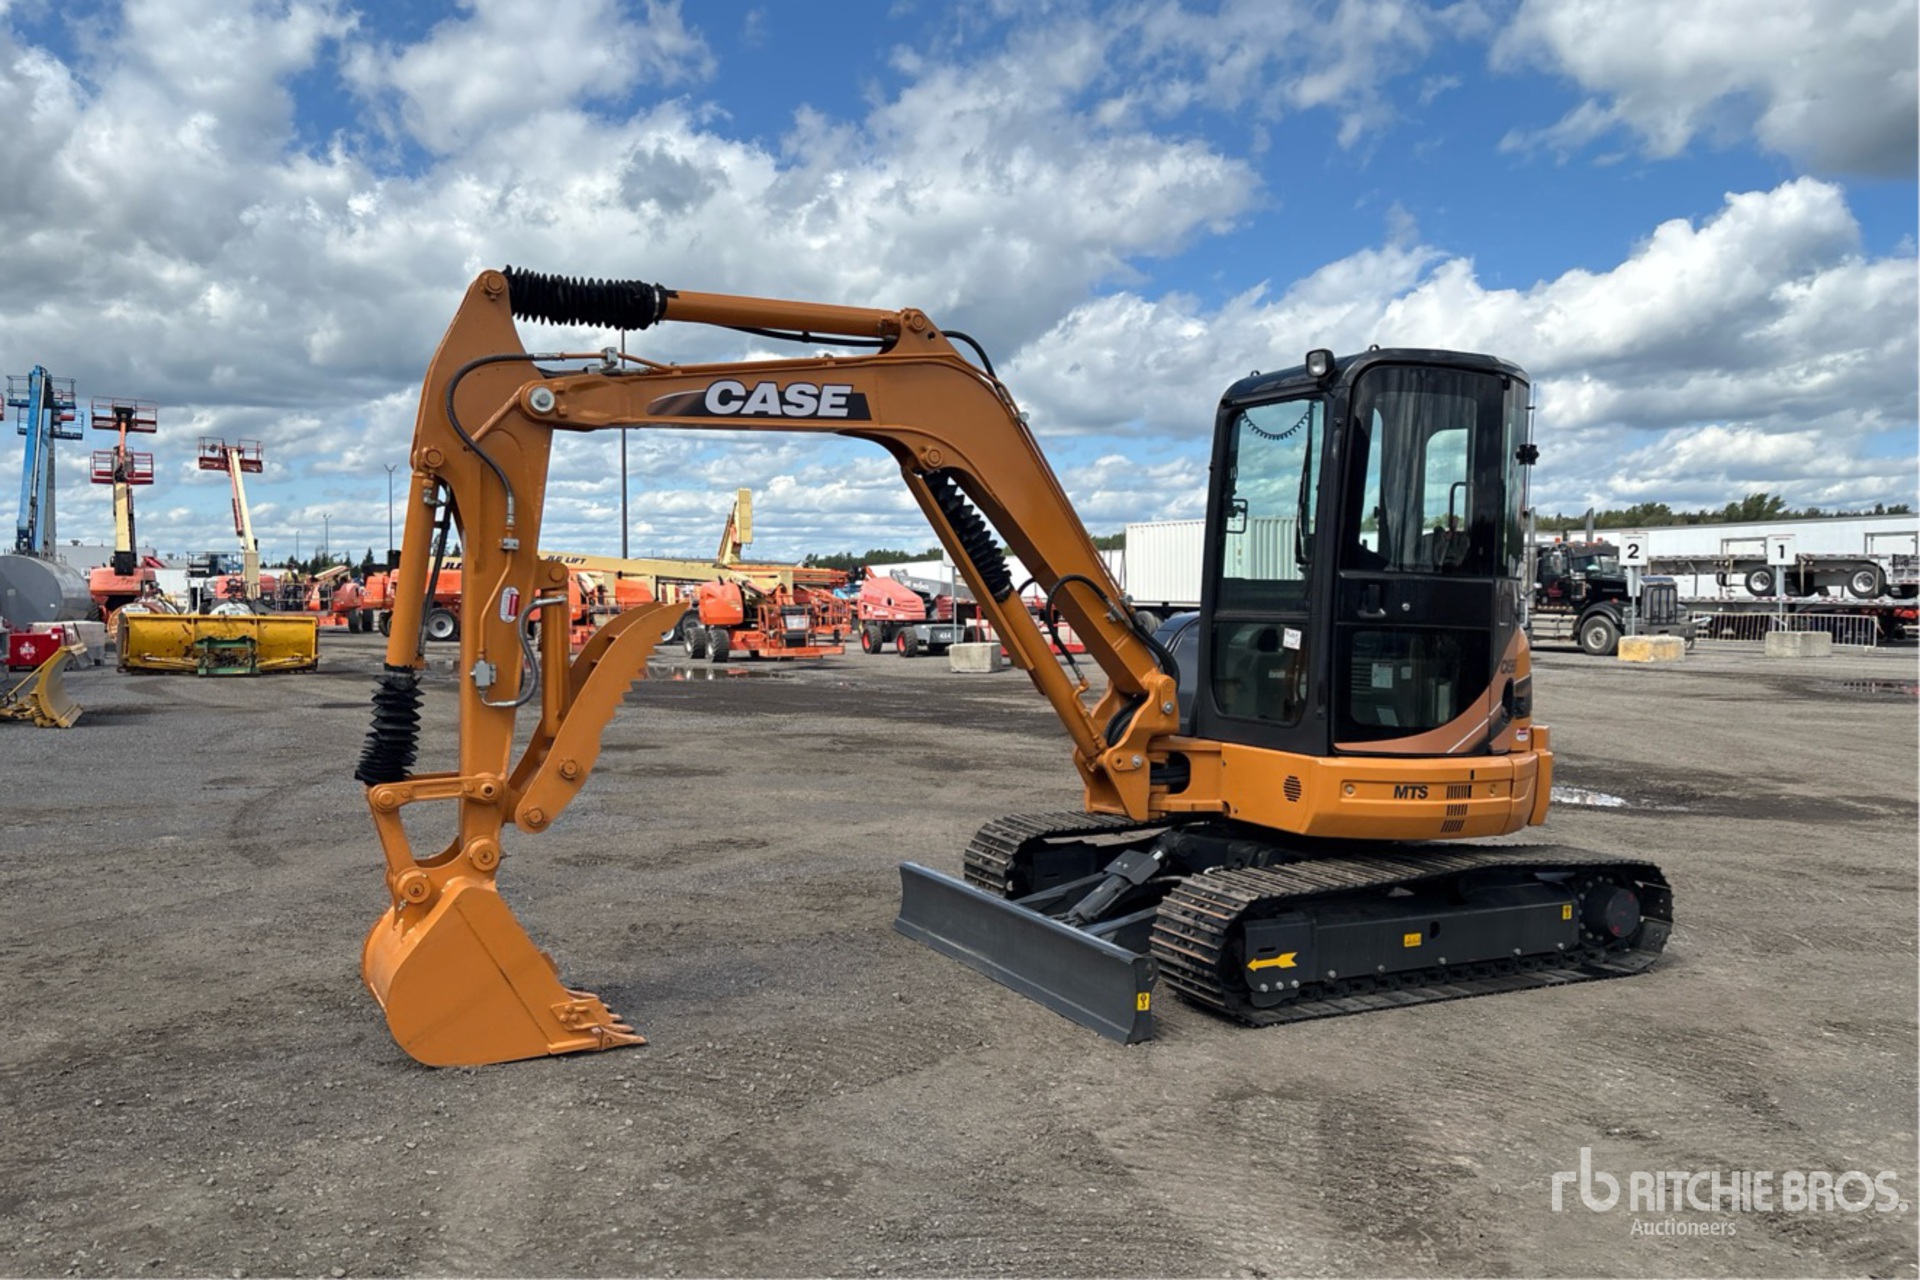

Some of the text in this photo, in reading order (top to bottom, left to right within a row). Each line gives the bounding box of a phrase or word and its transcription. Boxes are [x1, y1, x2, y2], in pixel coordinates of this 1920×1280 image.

[704, 379, 853, 418] CASE
[1627, 543, 1639, 559] 2
[1778, 544, 1785, 559] 1
[566, 557, 587, 565] LIFT
[1394, 785, 1429, 799] MTS
